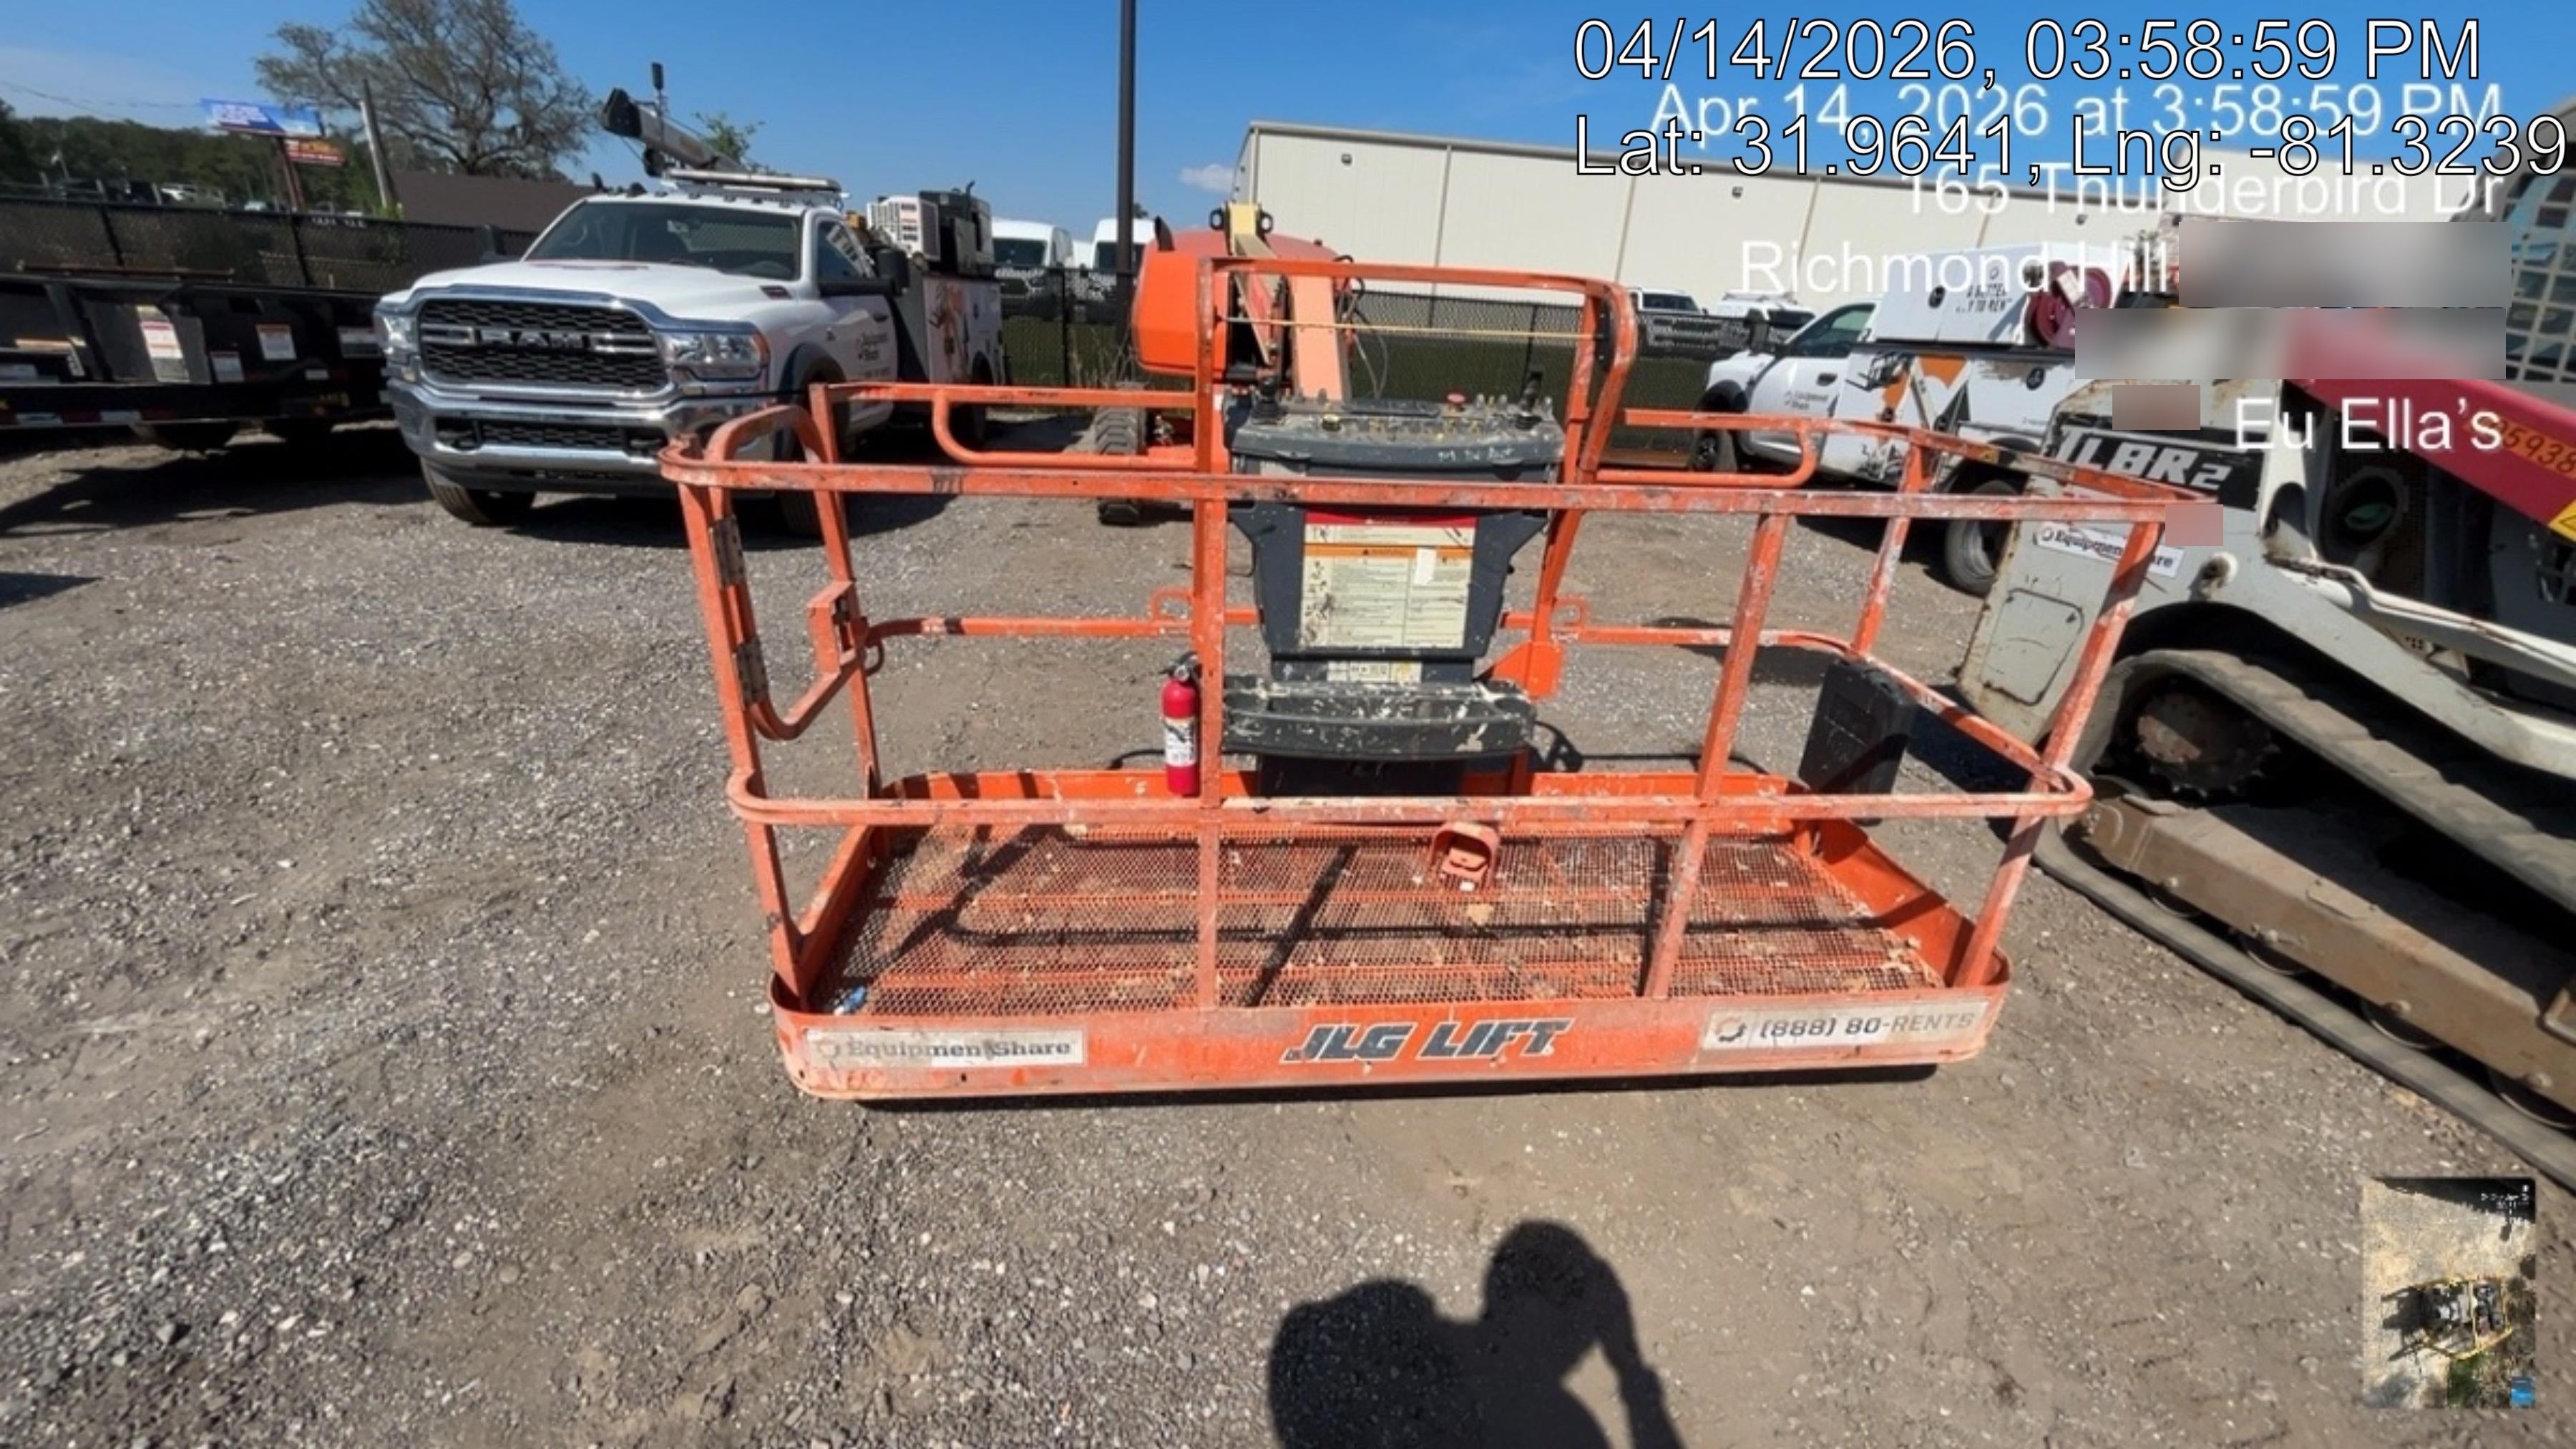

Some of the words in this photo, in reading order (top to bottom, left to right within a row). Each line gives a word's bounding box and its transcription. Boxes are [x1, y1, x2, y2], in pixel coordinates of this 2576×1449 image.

[479, 328, 588, 348] RAM
[1760, 1017, 1837, 1039] (888)
[1845, 1013, 1976, 1035] 80-RENTS
[1279, 1023, 1418, 1063] JLG
[1415, 1018, 1576, 1061] LIFT
